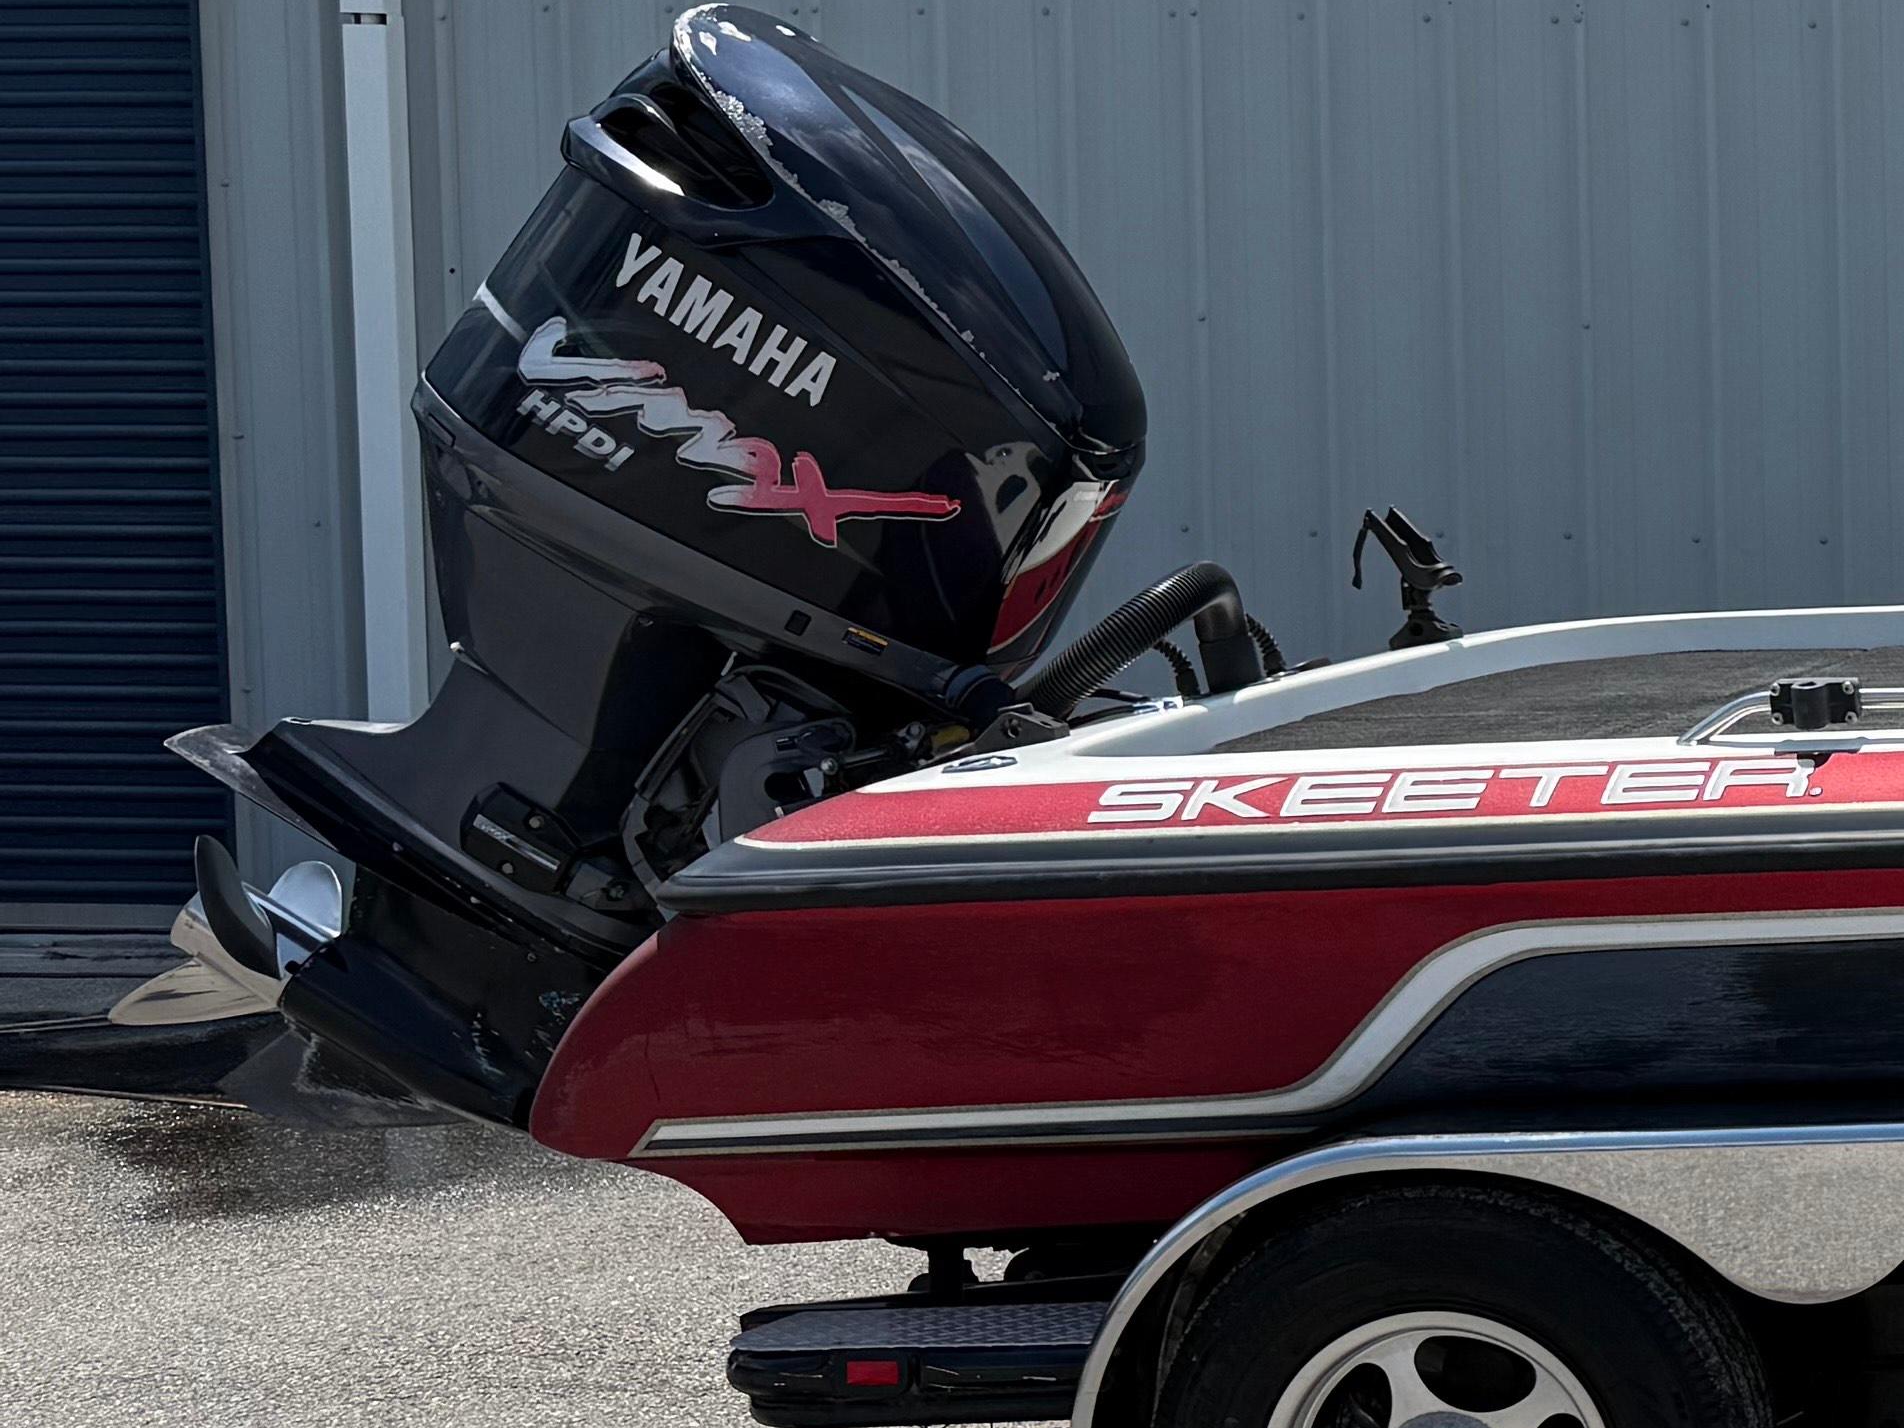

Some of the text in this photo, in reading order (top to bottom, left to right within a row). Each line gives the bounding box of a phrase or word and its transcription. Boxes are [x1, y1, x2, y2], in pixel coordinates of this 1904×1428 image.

[615, 232, 837, 407] YAMAHA
[516, 388, 636, 472] HPDI
[1086, 756, 1818, 825] SKEETER
